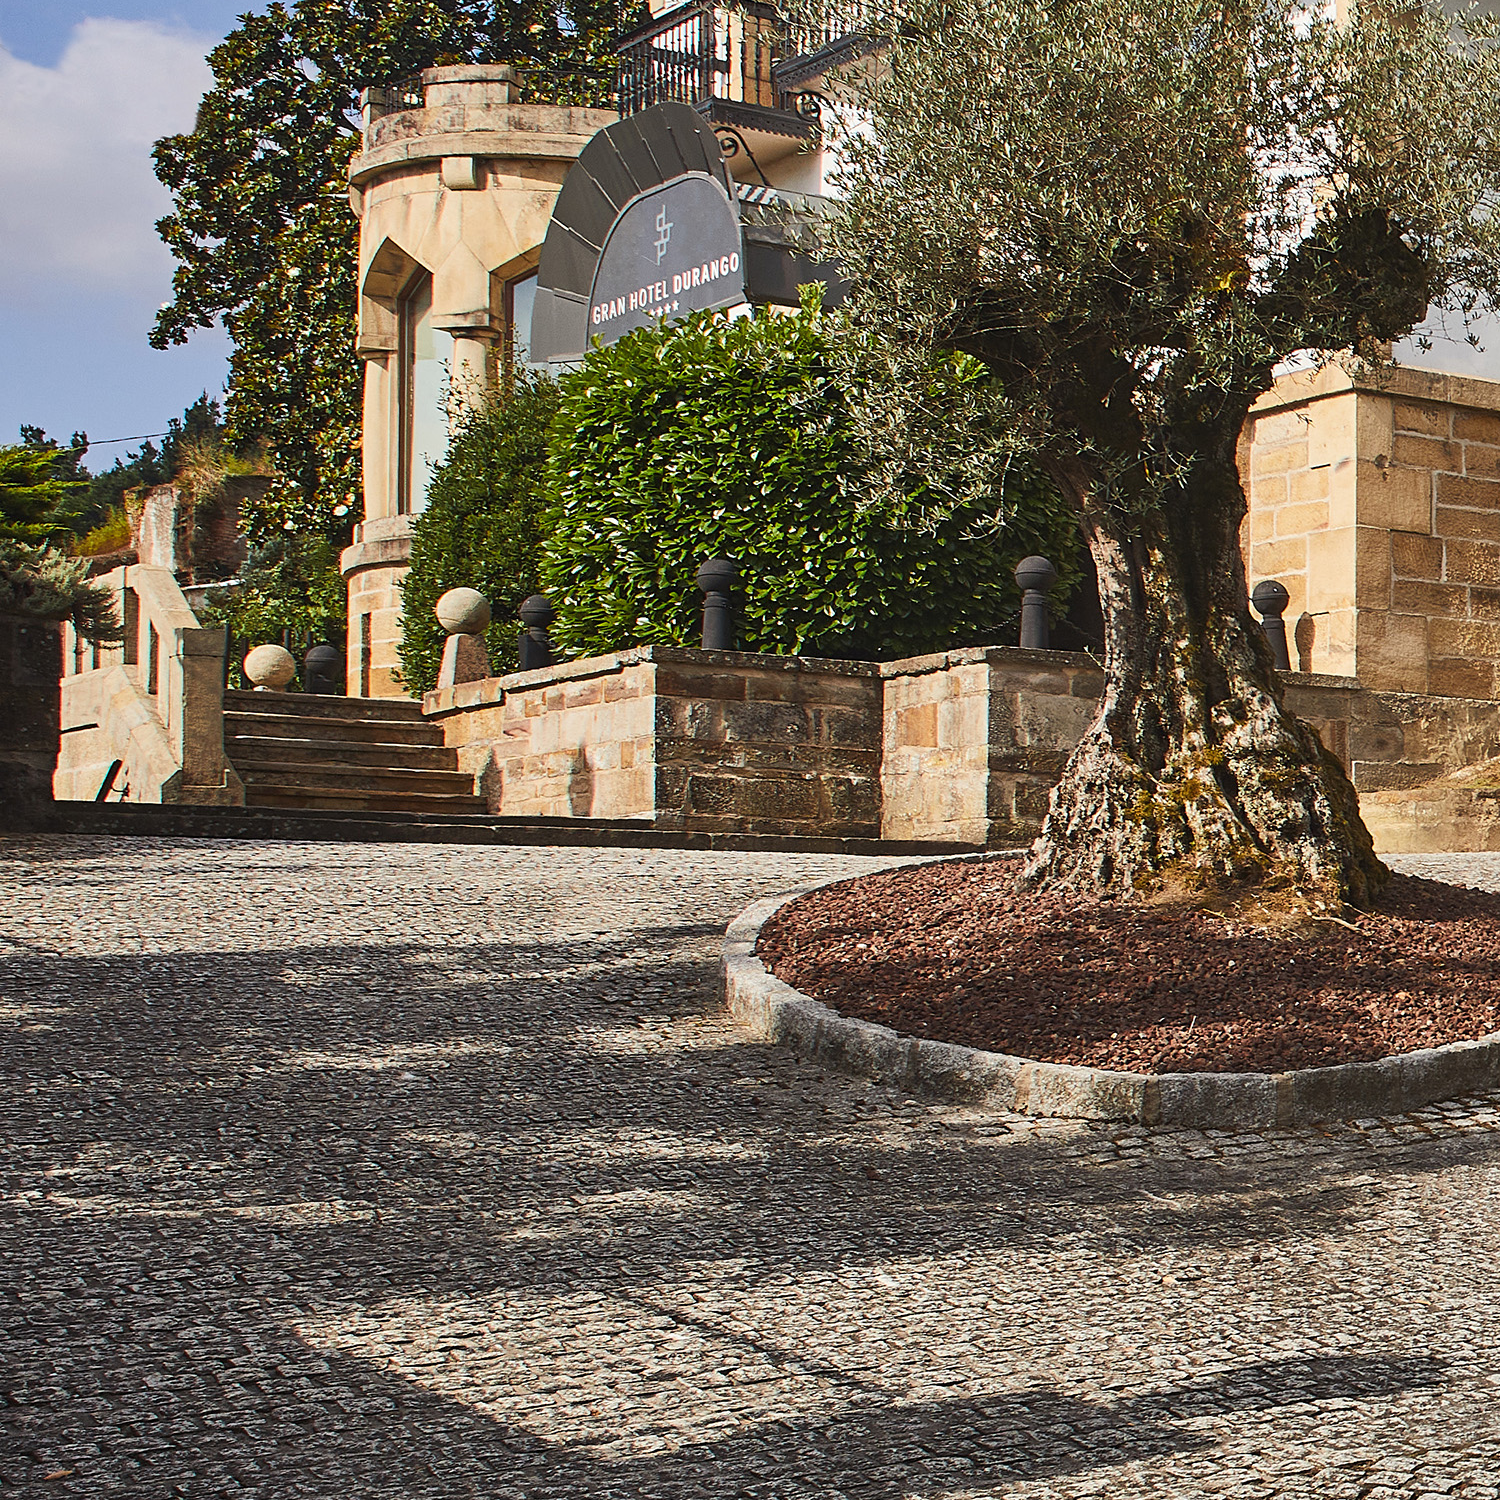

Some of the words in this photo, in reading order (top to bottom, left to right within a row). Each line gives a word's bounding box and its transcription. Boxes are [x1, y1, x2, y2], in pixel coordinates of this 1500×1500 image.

[592, 297, 626, 325] GRAN
[629, 280, 669, 312] HOTEL
[672, 252, 740, 295] DURANGO
